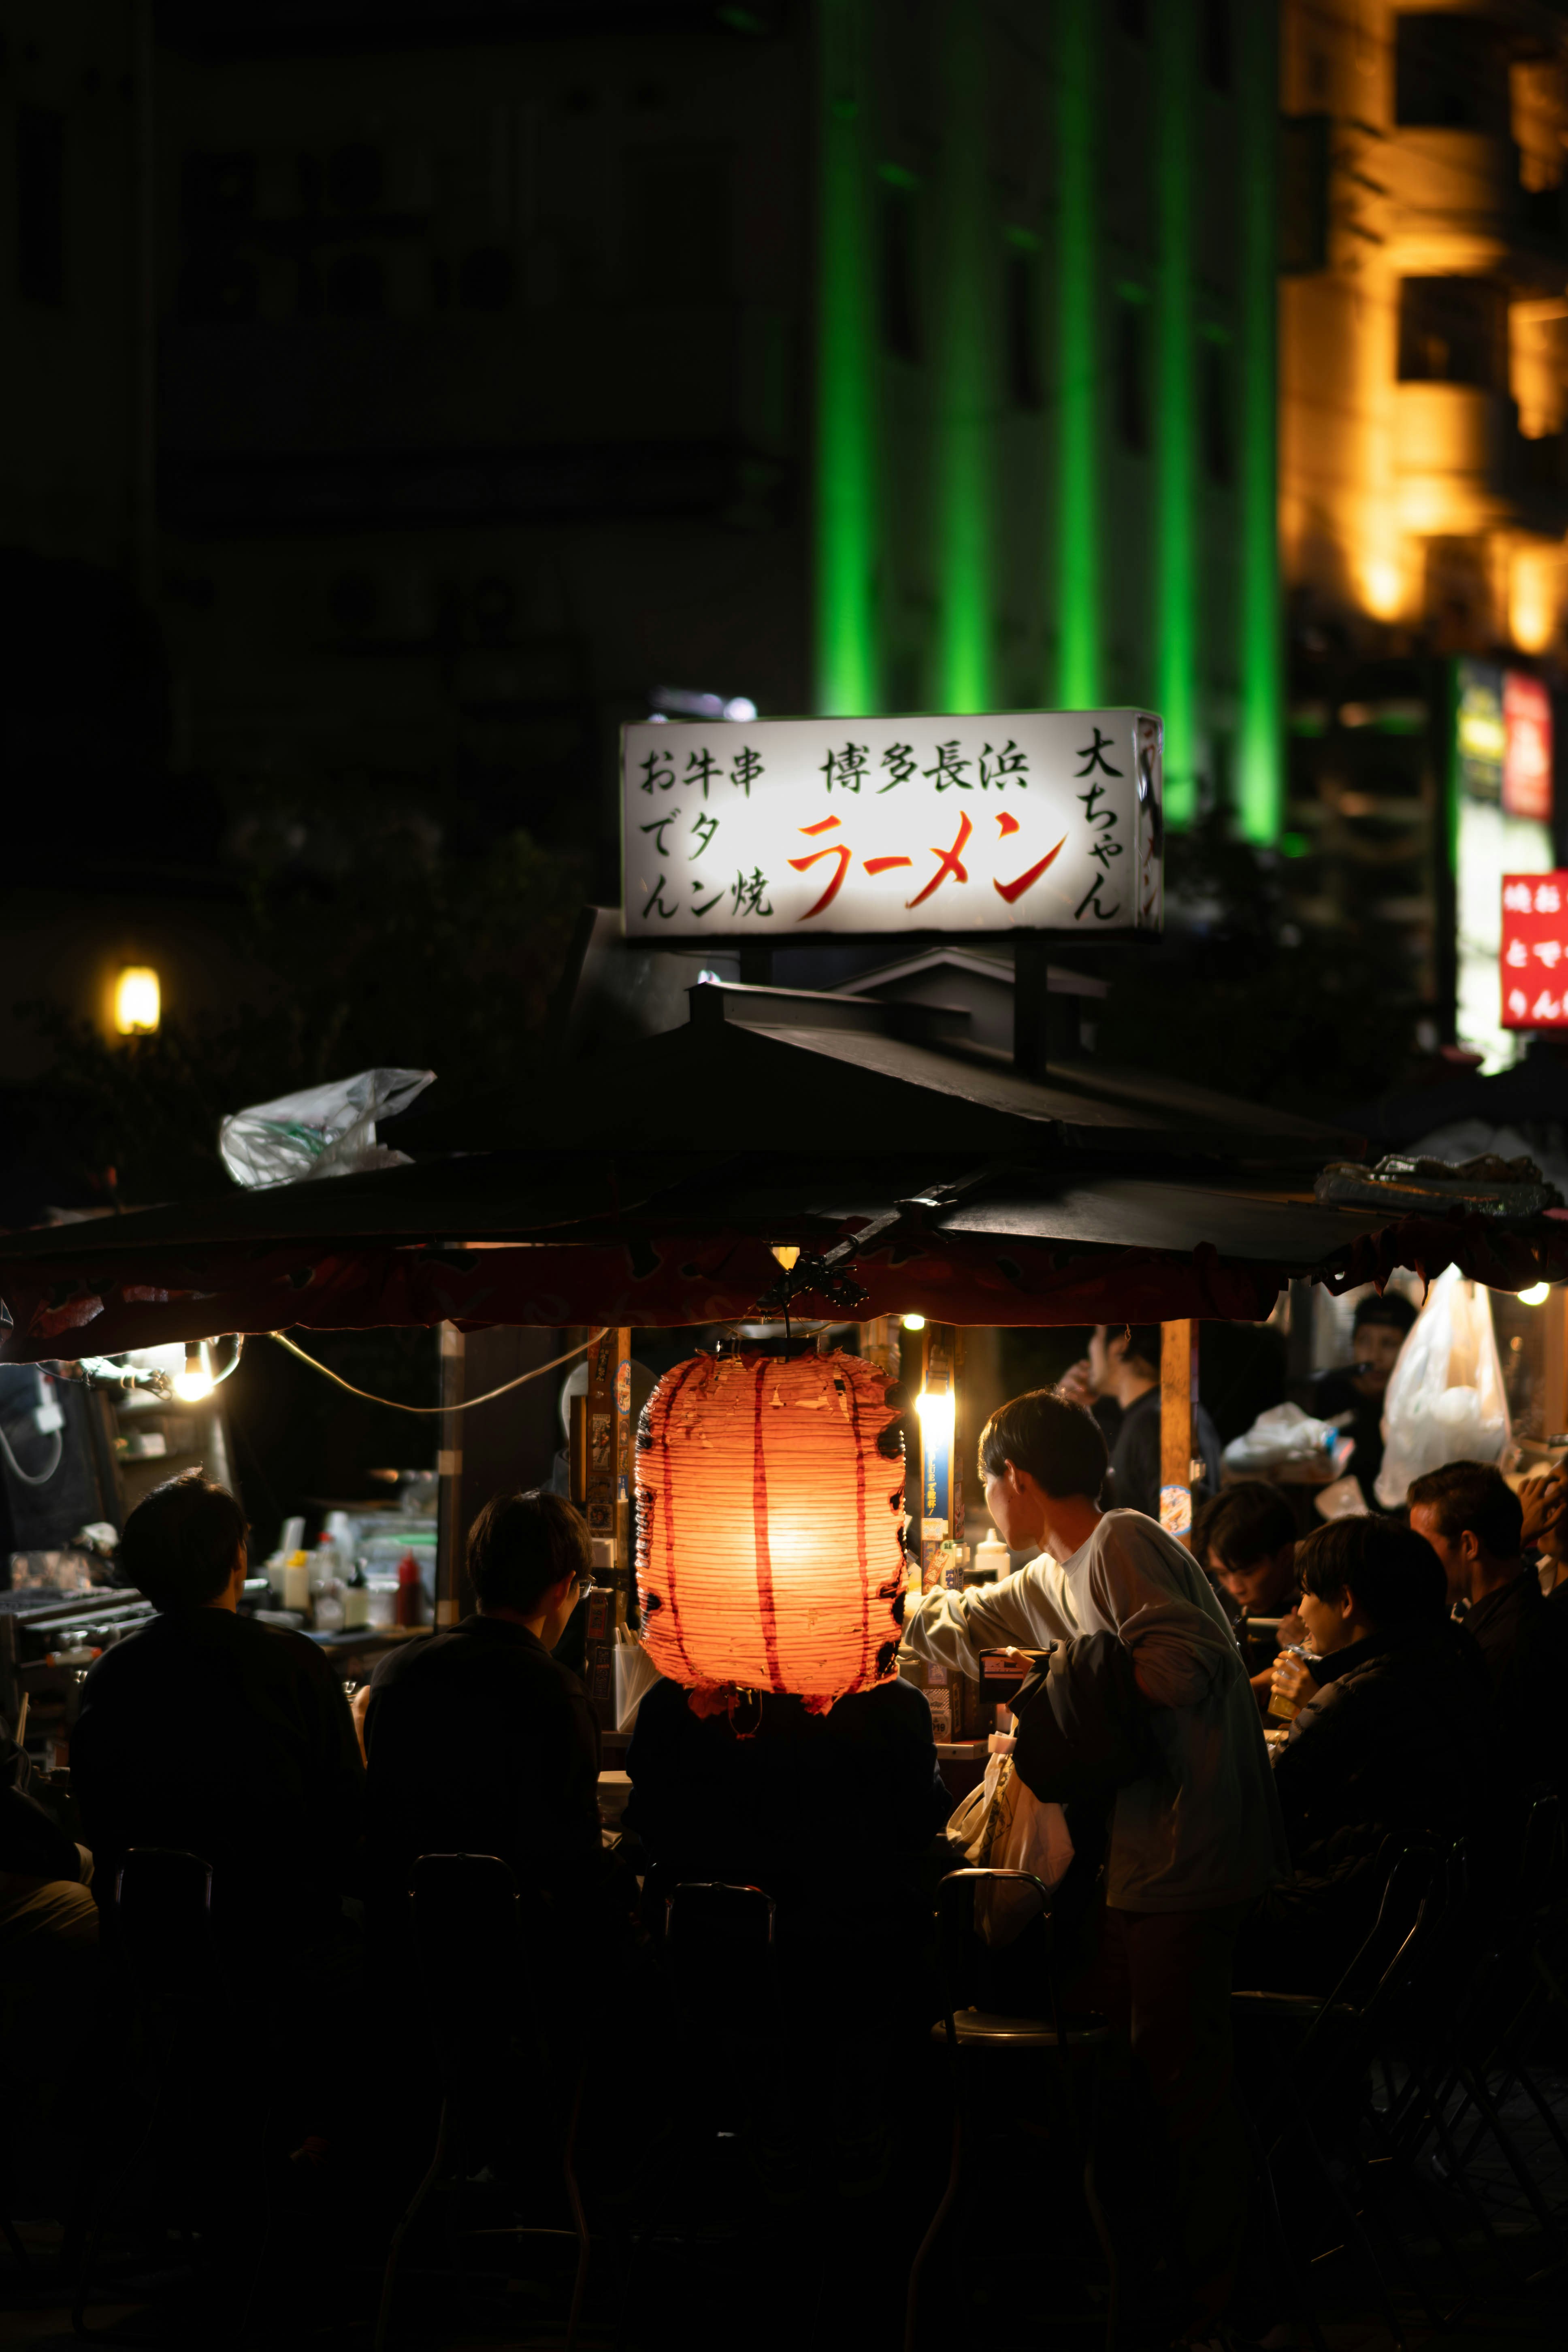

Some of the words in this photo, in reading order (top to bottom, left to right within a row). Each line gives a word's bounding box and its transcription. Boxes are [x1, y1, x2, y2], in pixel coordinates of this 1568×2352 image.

[639, 750, 681, 918] おでん
[682, 748, 726, 917] 牛タン
[730, 747, 774, 918] 串焼
[820, 740, 1030, 794] 博多長浜
[1074, 728, 1124, 921] 大ちゃん
[787, 810, 1069, 922] ラーメン
